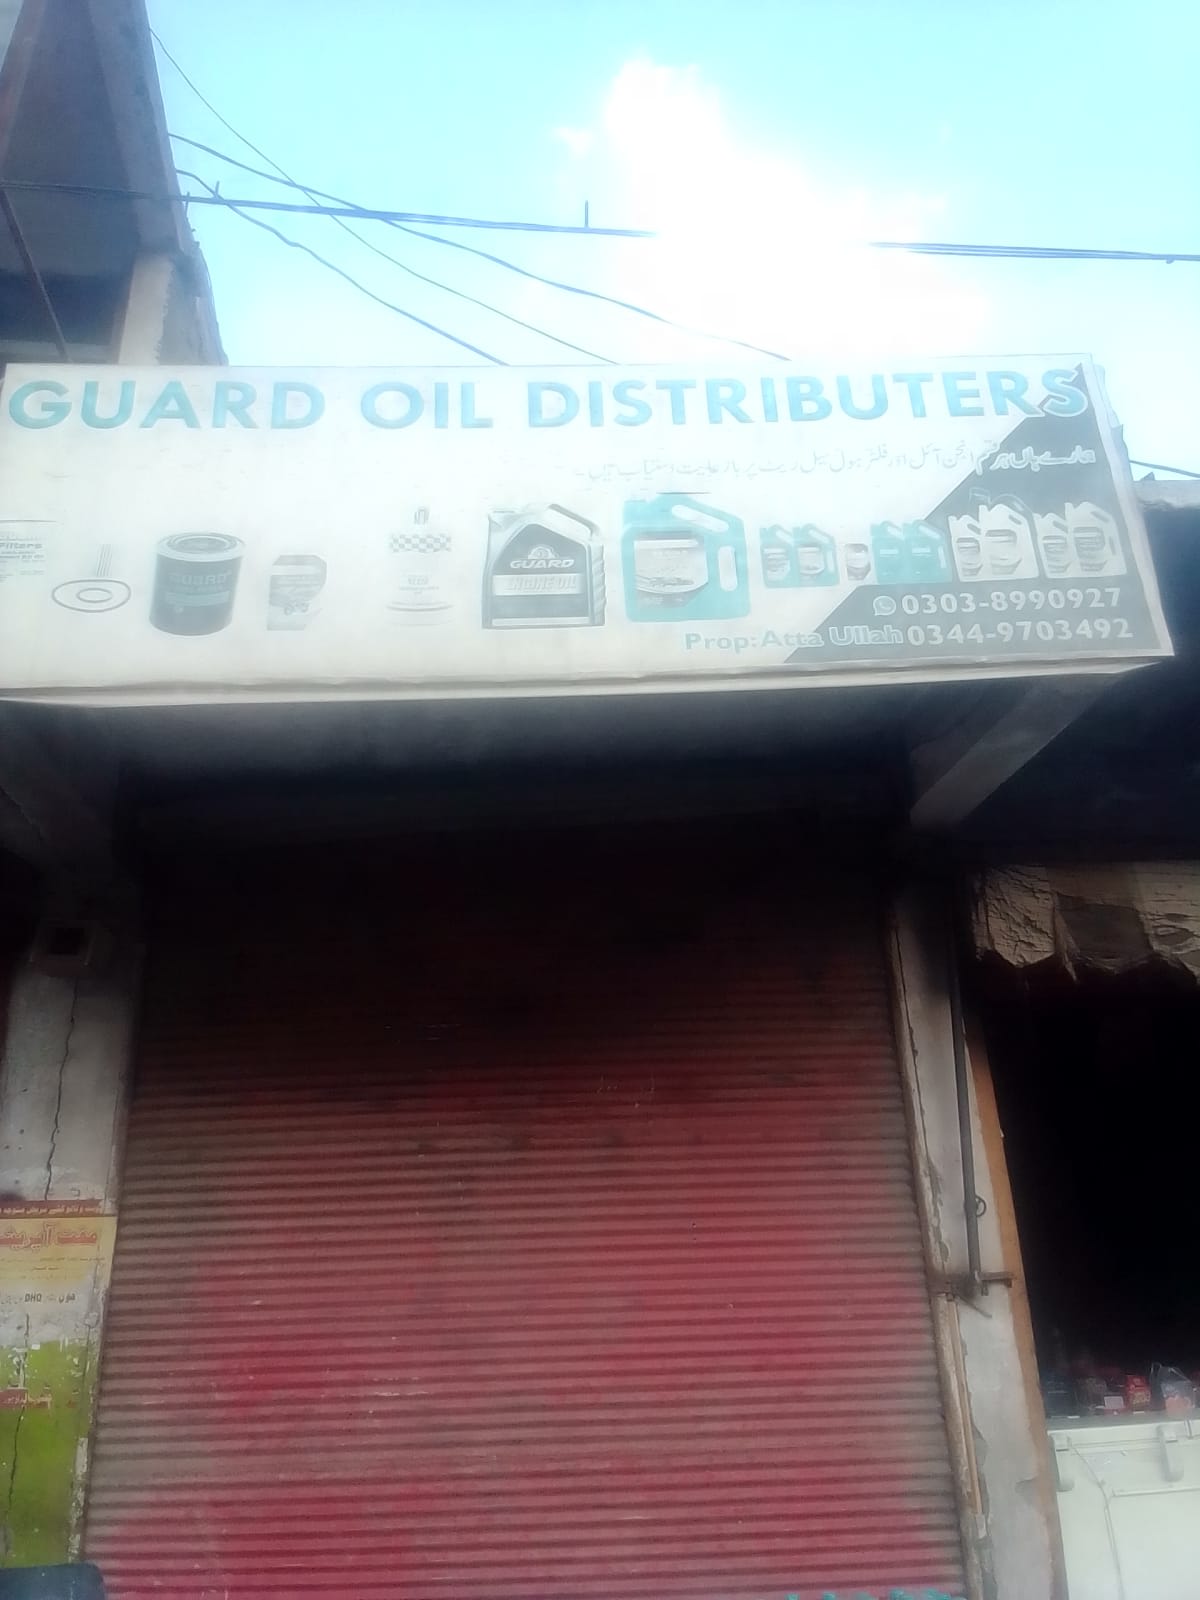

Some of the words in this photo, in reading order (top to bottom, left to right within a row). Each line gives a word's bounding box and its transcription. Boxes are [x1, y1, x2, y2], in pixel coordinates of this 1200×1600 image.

[8, 379, 326, 430] GUARD
[360, 381, 494, 429] OIL
[528, 367, 1090, 428] DISTRIBUTERS
[510, 559, 575, 569] GUARD
[902, 587, 1121, 615] 0303-8990927
[829, 625, 904, 647] Ullah
[908, 618, 1133, 646] 0344-9703492
